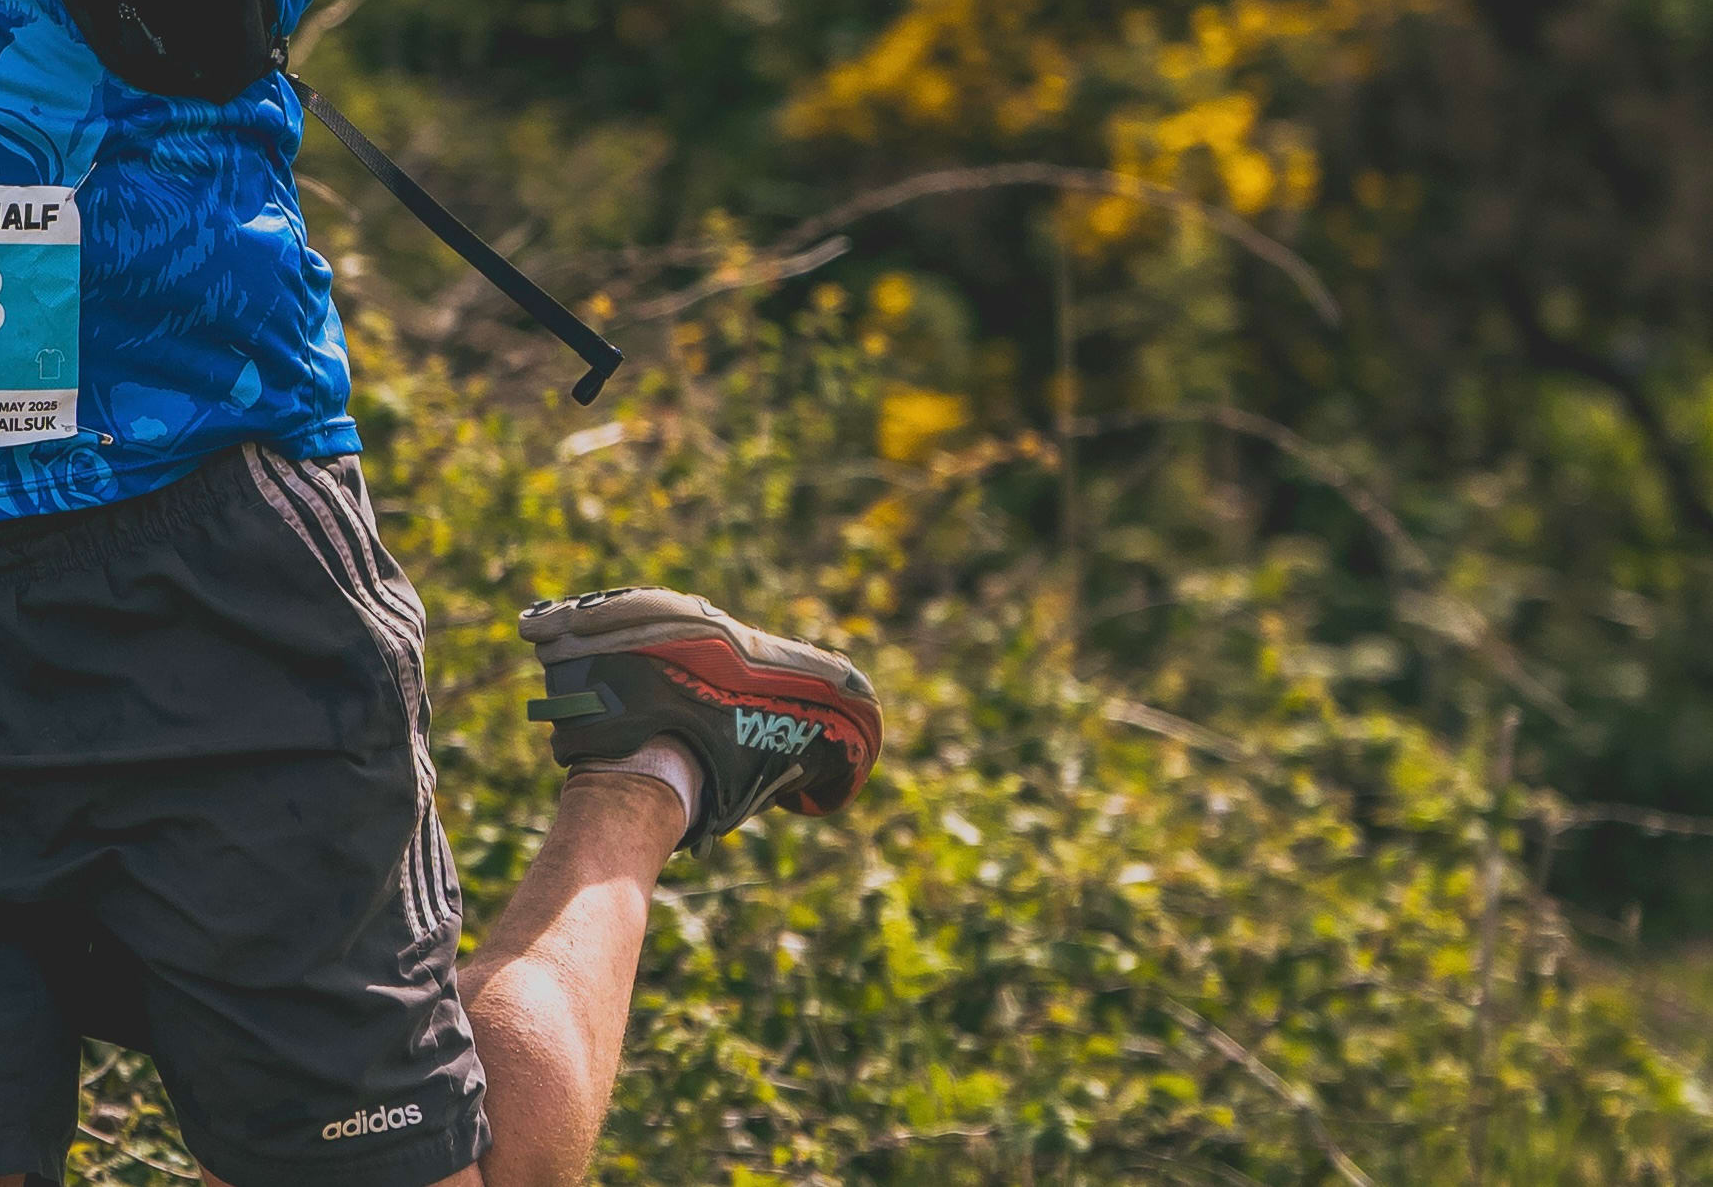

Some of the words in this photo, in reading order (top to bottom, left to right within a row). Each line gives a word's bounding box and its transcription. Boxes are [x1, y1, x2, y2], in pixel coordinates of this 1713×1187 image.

[28, 401, 58, 411] 2025
[735, 707, 822, 754] HOKA
[322, 1103, 423, 1140] adidas
